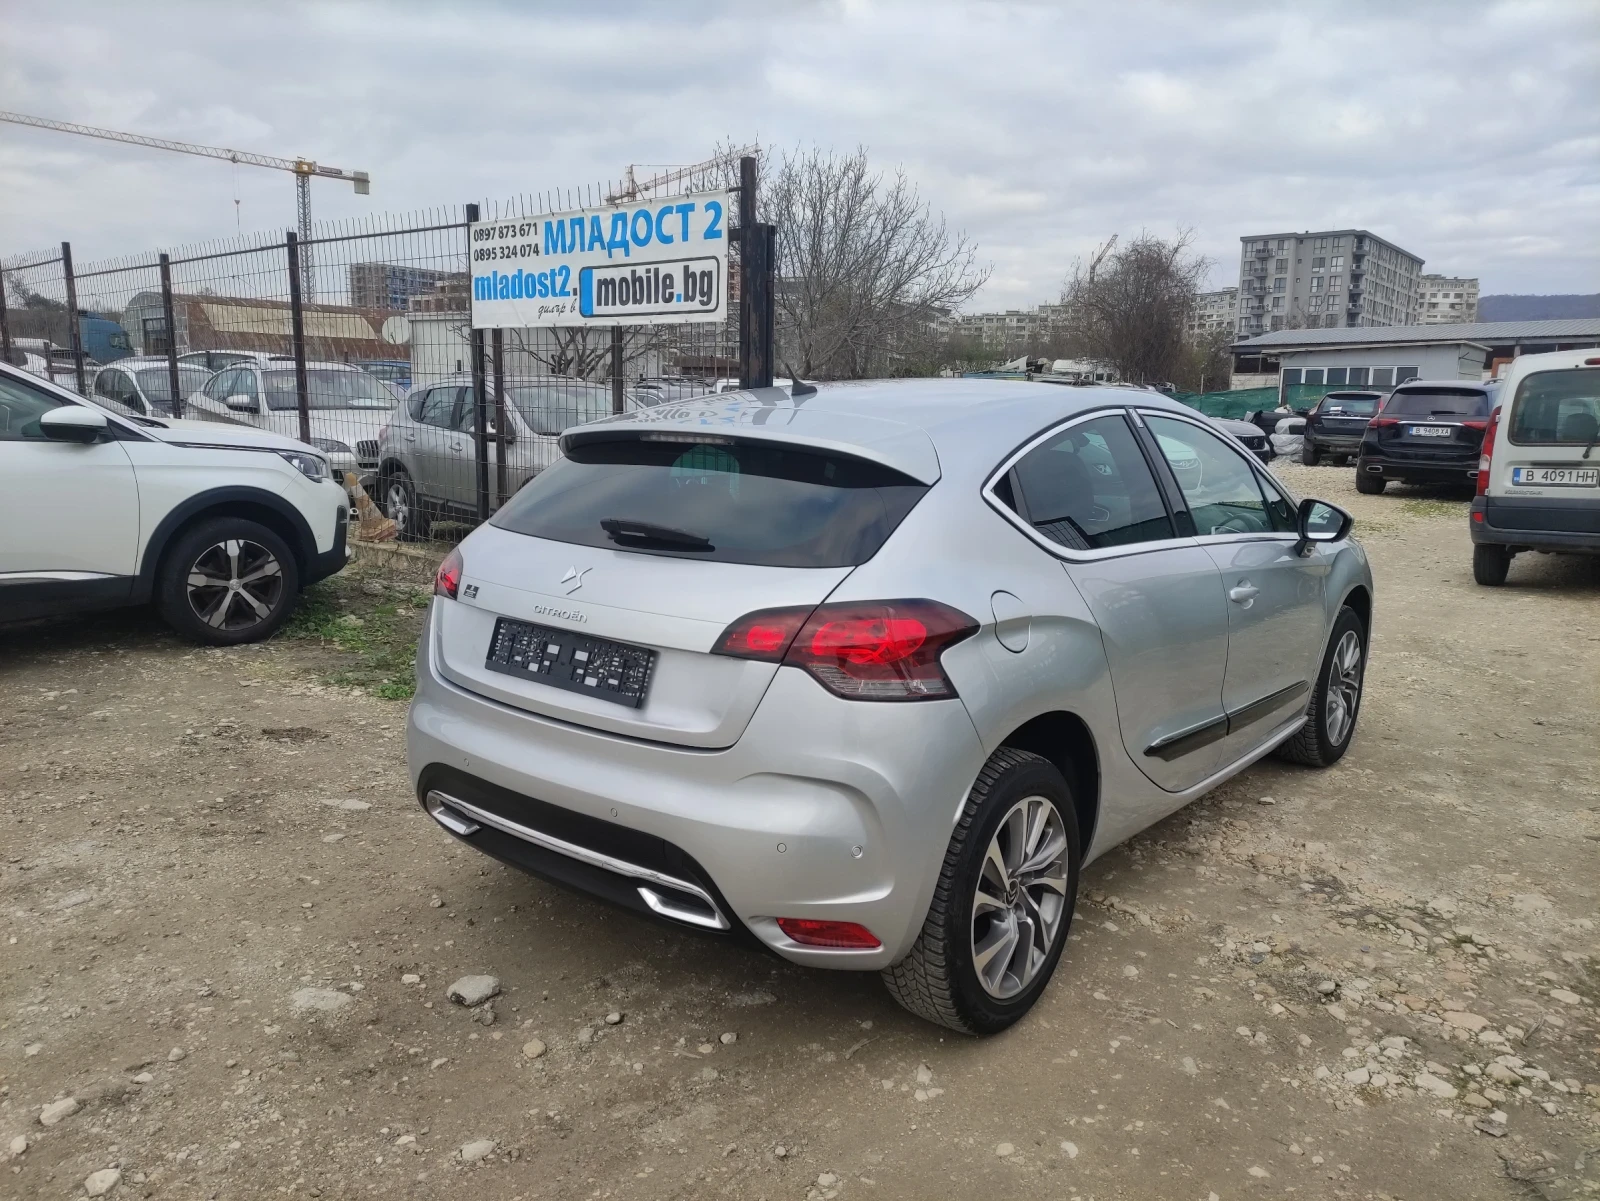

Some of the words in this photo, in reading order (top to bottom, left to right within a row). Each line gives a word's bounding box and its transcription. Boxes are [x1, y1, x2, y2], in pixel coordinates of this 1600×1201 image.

[473, 226, 497, 242] 0897
[498, 224, 517, 240] 873
[519, 222, 538, 238] 671
[544, 202, 696, 259] МЛАДОСТ
[703, 201, 723, 240] 2
[473, 246, 498, 262] 0895
[499, 244, 518, 260] 324
[519, 243, 540, 258] 074
[596, 264, 713, 307] mobile.bg
[1526, 470, 1535, 482] B
[1541, 470, 1573, 482] 4091
